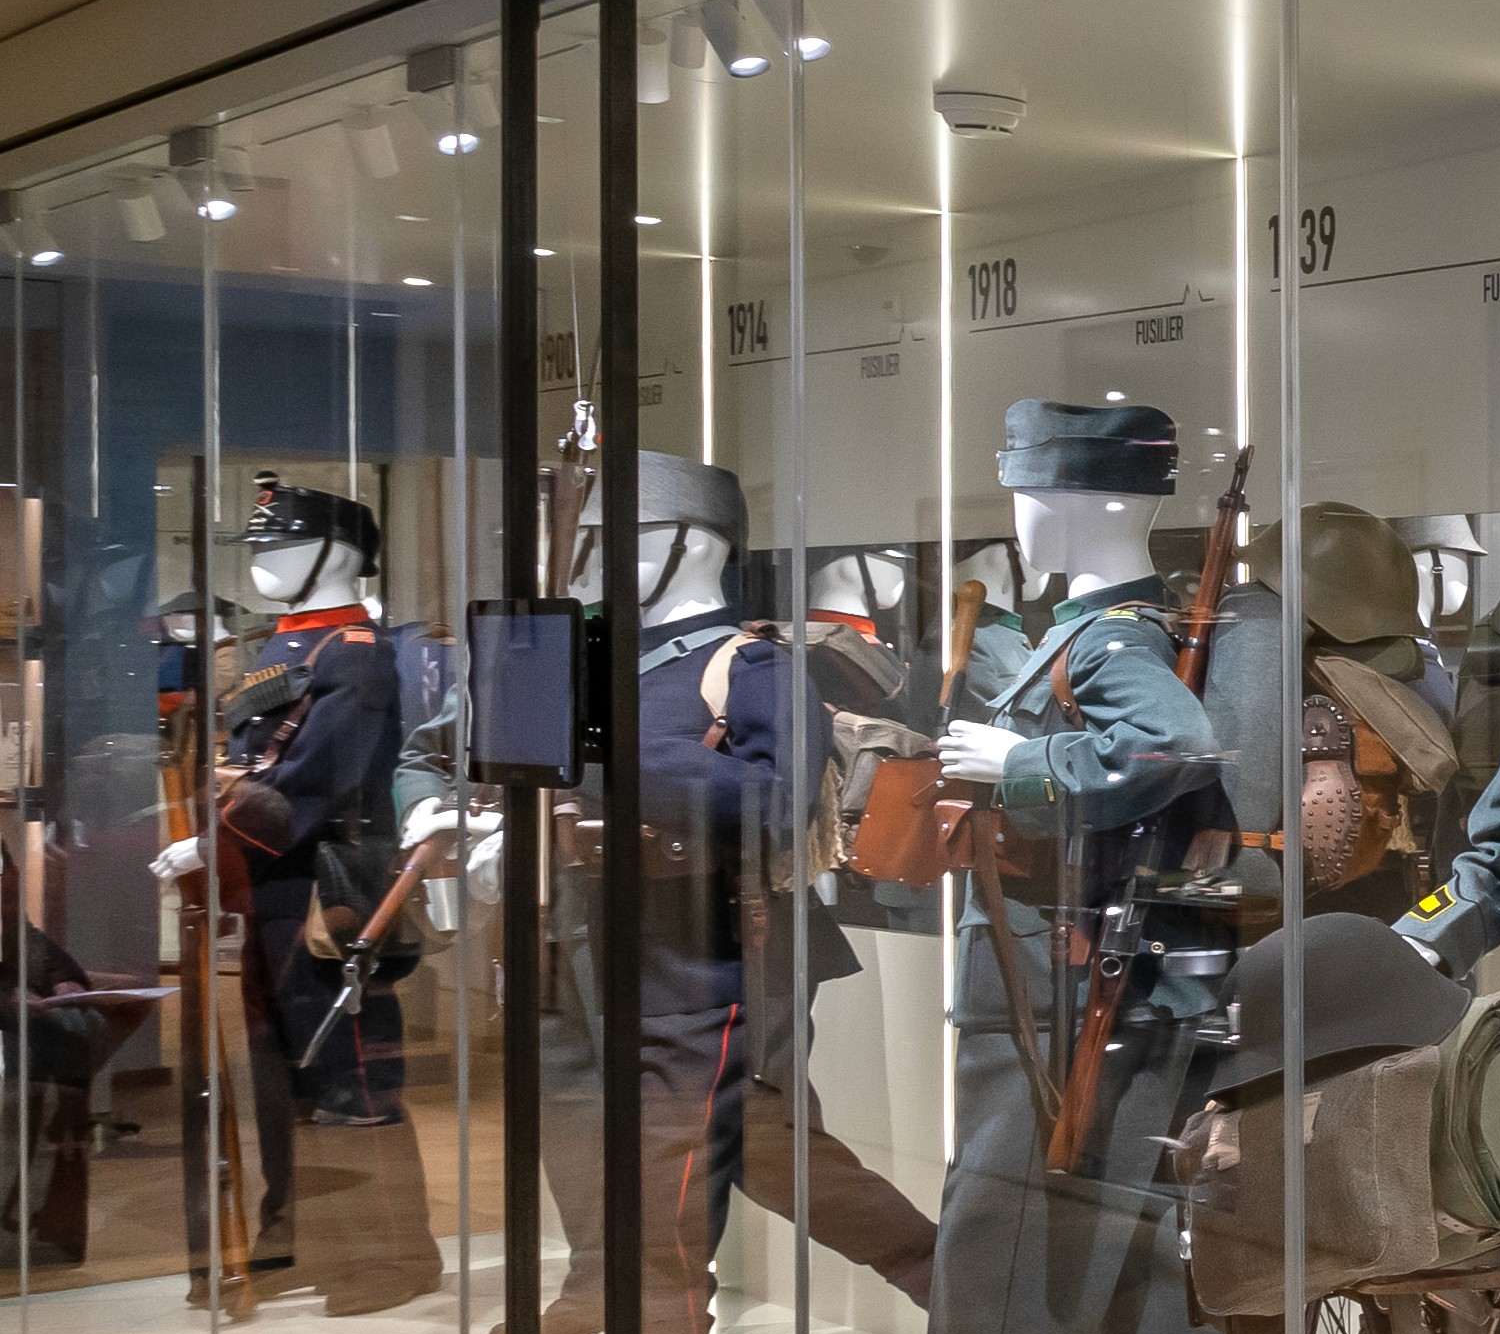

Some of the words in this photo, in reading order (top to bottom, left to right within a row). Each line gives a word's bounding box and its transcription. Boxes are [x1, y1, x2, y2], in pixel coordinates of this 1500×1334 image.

[1269, 206, 1335, 279] 139
[967, 257, 1017, 321] 1918
[728, 299, 768, 356] 1914
[1135, 315, 1184, 346] FUSILIER
[861, 353, 900, 380] FUSILIER
